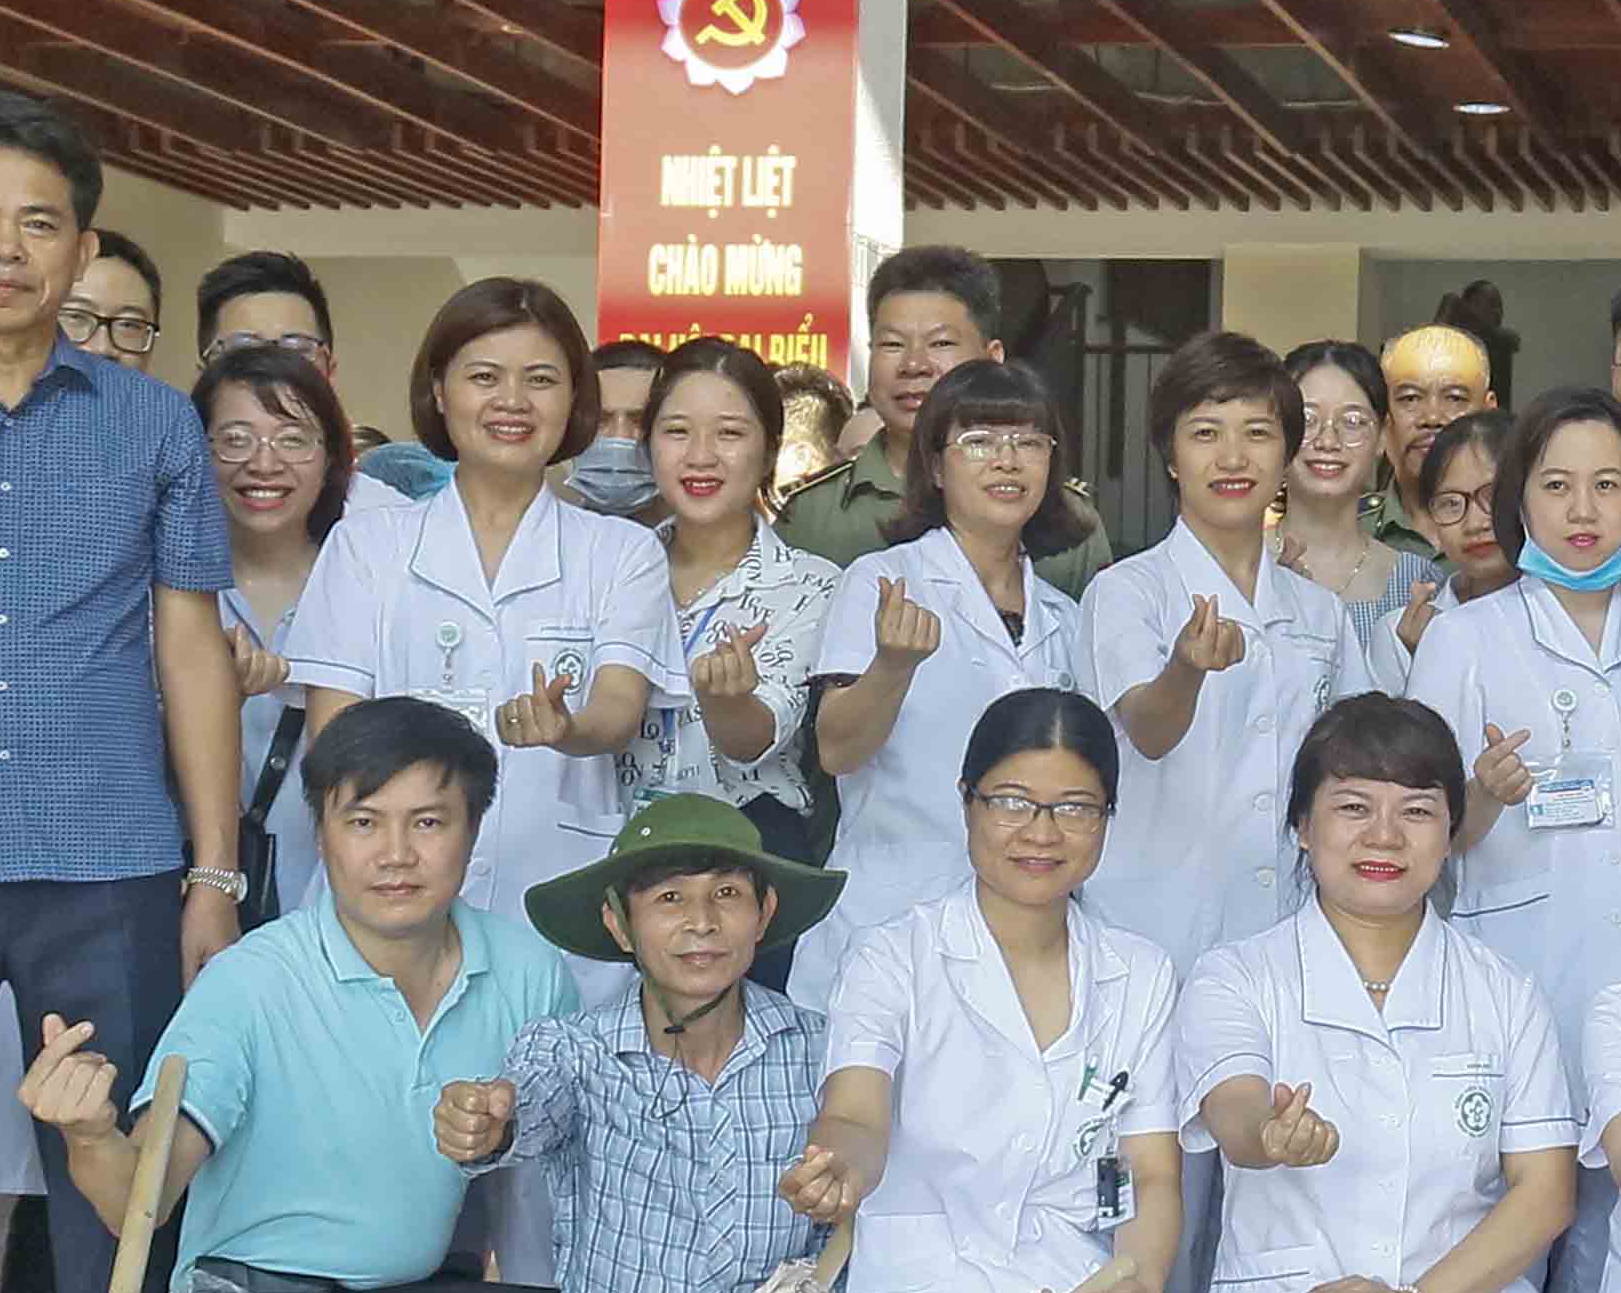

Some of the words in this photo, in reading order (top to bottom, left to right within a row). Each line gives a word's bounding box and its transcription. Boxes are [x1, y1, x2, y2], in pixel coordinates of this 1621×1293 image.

[660, 144, 738, 219] NHIỆT
[741, 144, 796, 219] LIỆT
[647, 233, 719, 296] CHÀO
[723, 233, 804, 296] MỪNG
